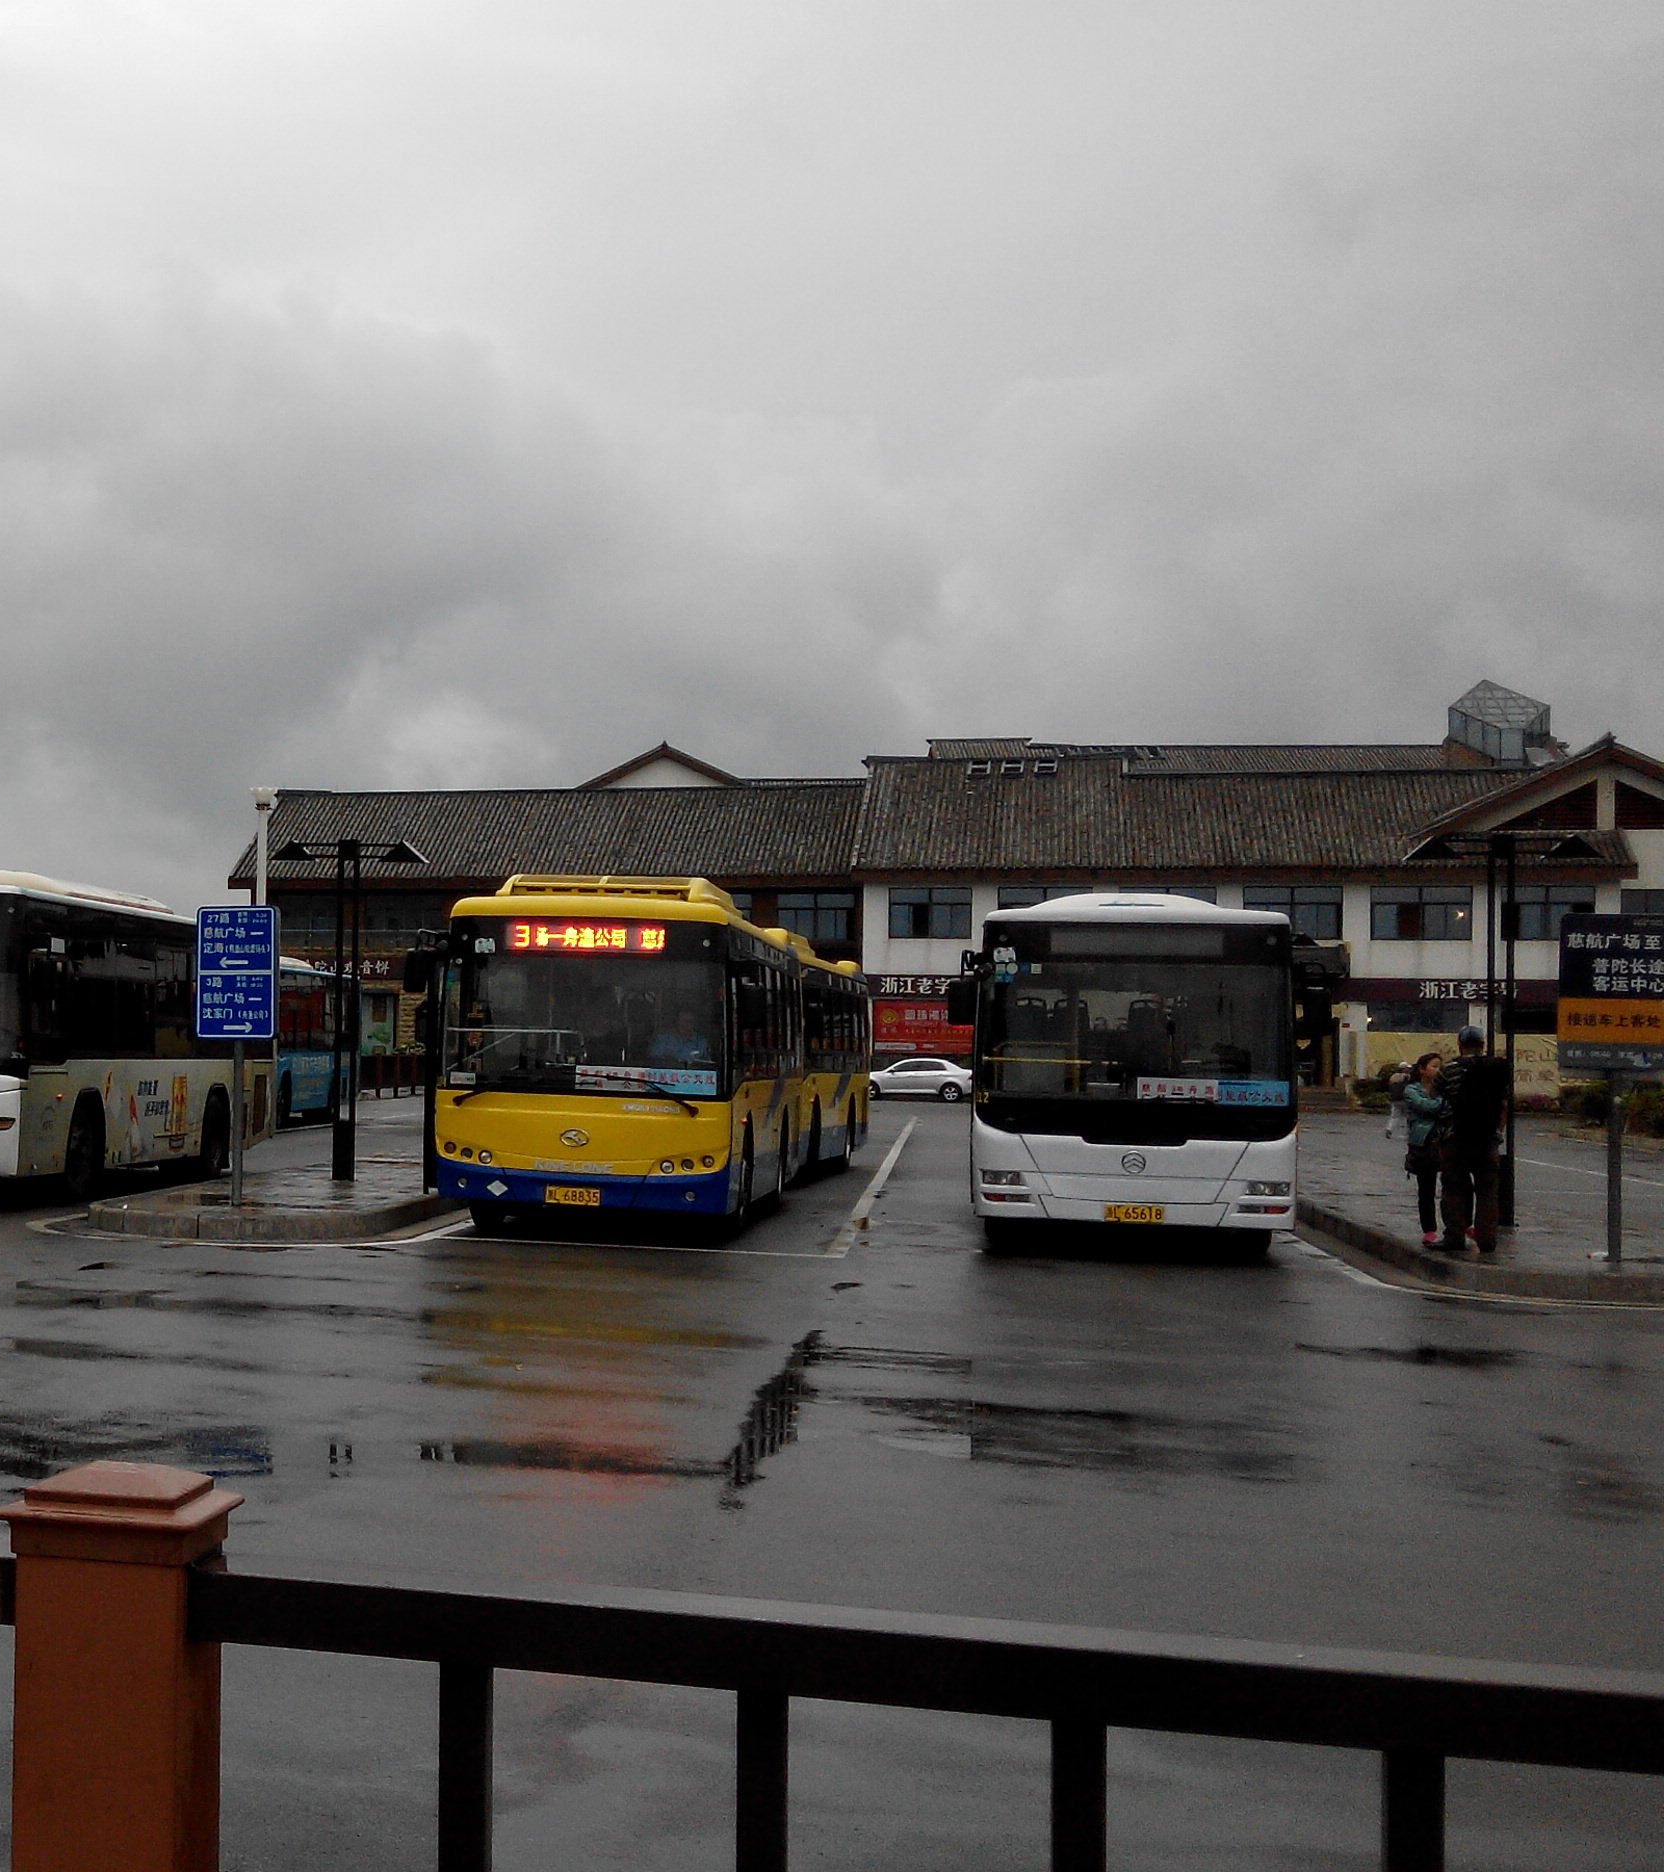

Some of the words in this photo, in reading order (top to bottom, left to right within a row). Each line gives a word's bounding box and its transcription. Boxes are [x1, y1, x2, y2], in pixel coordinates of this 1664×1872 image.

[1593, 976, 1664, 993] 客运中心
[202, 1007, 233, 1020] 沈家门
